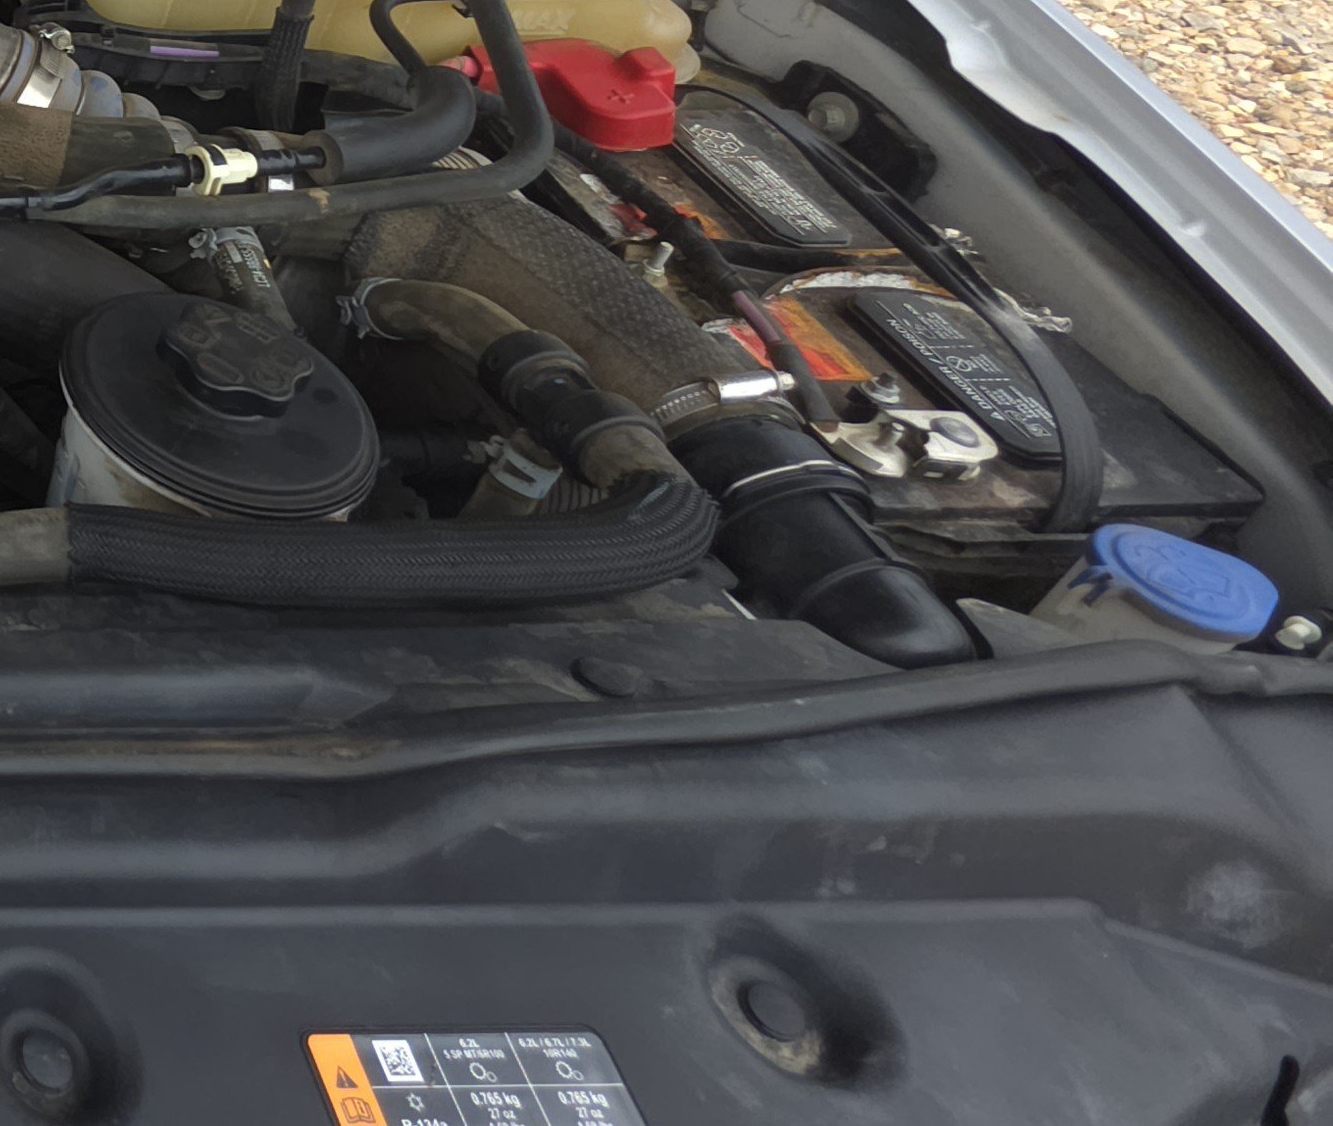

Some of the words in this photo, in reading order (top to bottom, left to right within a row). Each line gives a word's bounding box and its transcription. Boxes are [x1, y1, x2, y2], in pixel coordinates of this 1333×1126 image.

[886, 319, 933, 355] POISON
[938, 366, 993, 410] DANGER
[470, 1091, 503, 1107] 0.765
[502, 1091, 522, 1110] kg
[557, 1091, 590, 1105] 0.765
[589, 1091, 610, 1108] kg
[487, 1107, 501, 1120] 27
[502, 1109, 517, 1120] oz
[575, 1106, 589, 1118] 27
[590, 1109, 605, 1118] oz
